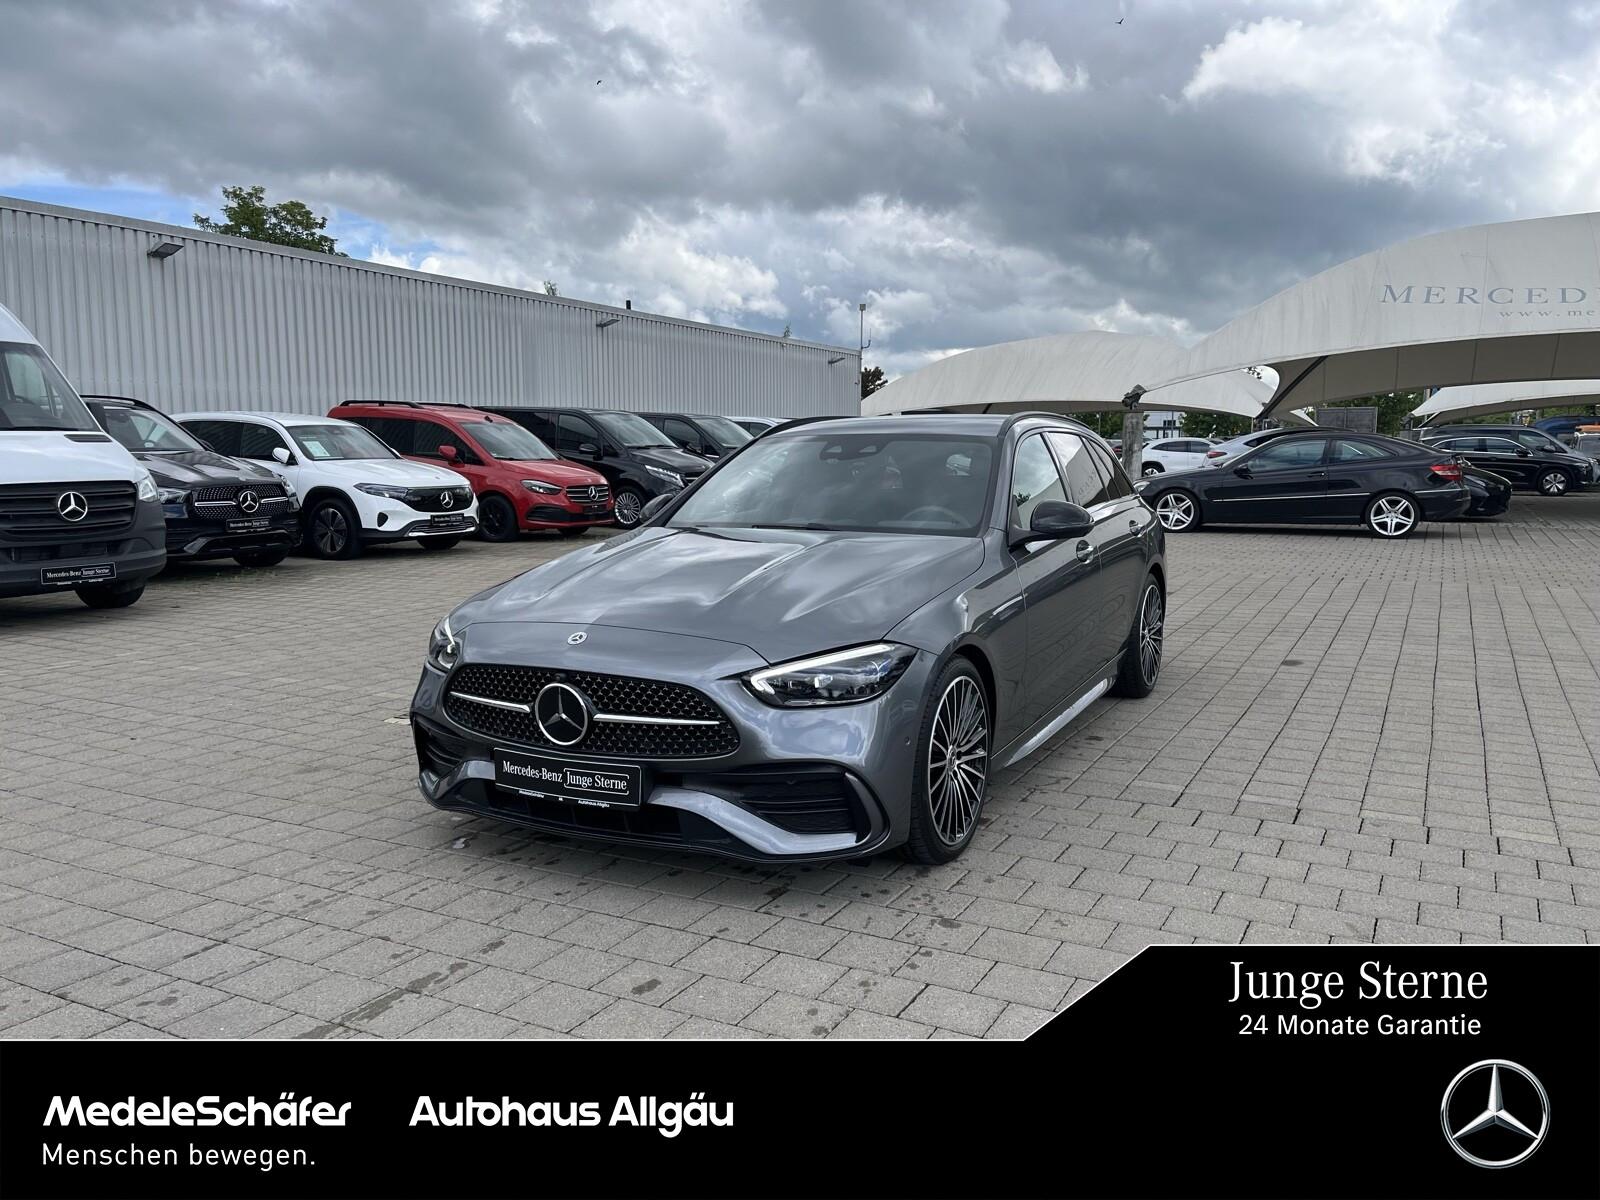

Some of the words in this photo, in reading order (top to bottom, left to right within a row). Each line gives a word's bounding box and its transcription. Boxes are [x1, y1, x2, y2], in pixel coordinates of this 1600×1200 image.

[1381, 284, 1600, 304] MERCED
[503, 760, 562, 783] Mercedes-Benz
[566, 771, 592, 788] Junge
[594, 774, 627, 790] Sterne
